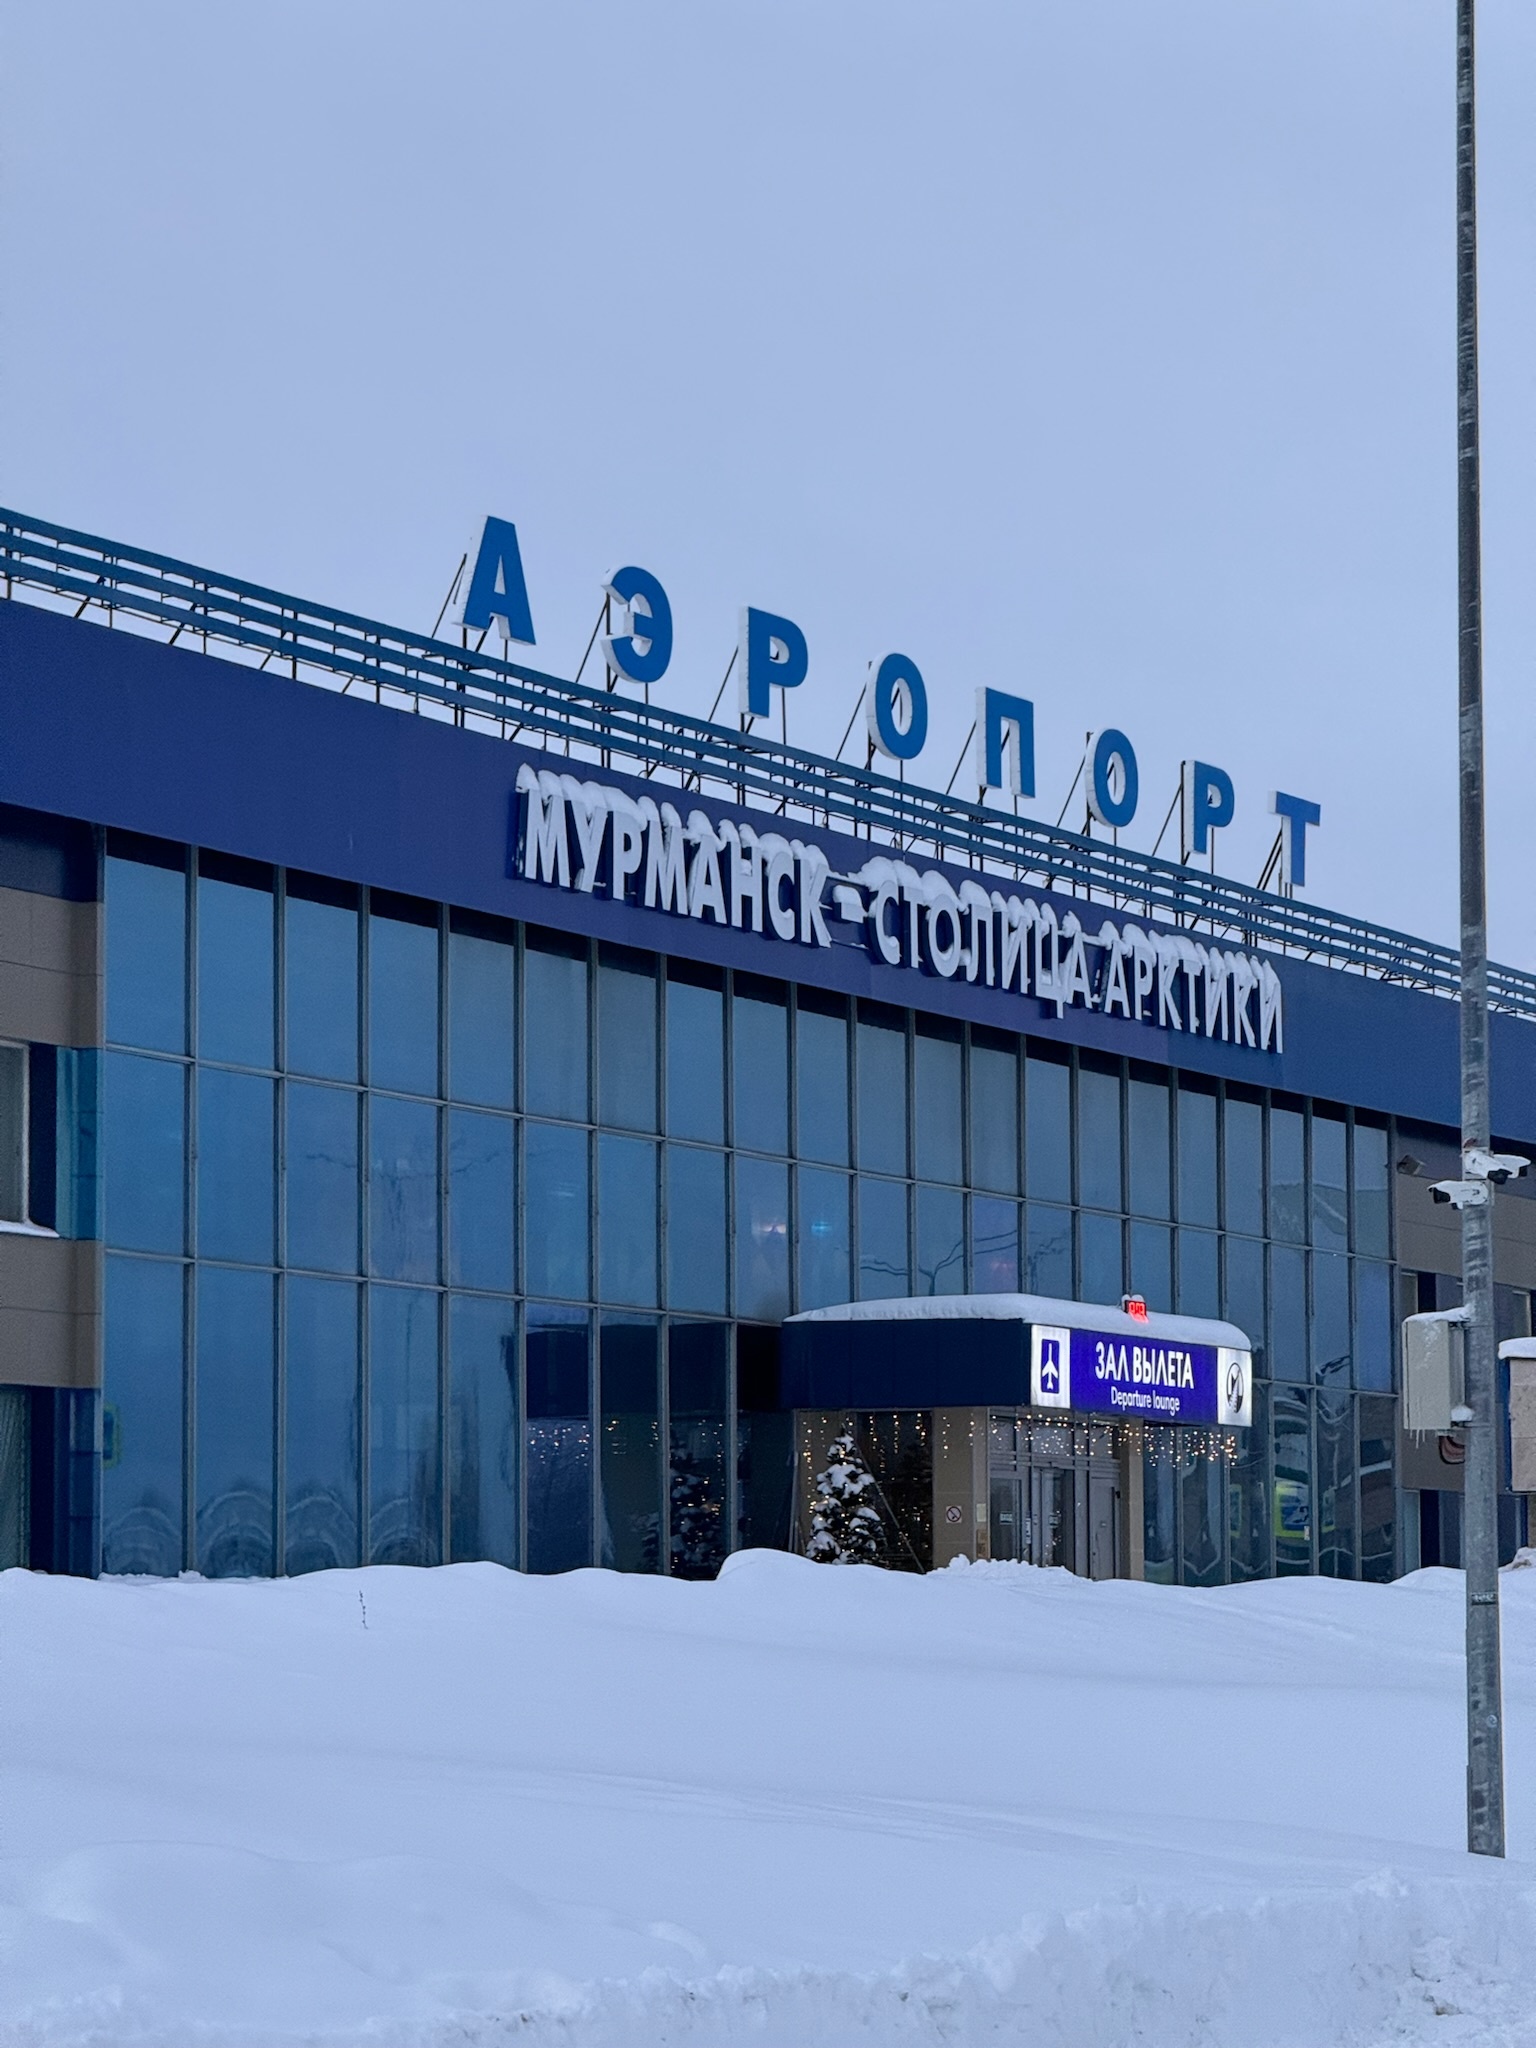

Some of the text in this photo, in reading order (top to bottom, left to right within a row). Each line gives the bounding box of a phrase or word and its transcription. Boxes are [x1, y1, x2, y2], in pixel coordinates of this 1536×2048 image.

[454, 515, 1321, 888] АЭРОПОРТ
[1104, 930, 1284, 1054] АРКТИКИ
[1095, 1341, 1194, 1389] ЗАЛ ВЫЛЕТА
[1111, 1386, 1180, 1416] Departure lounge
